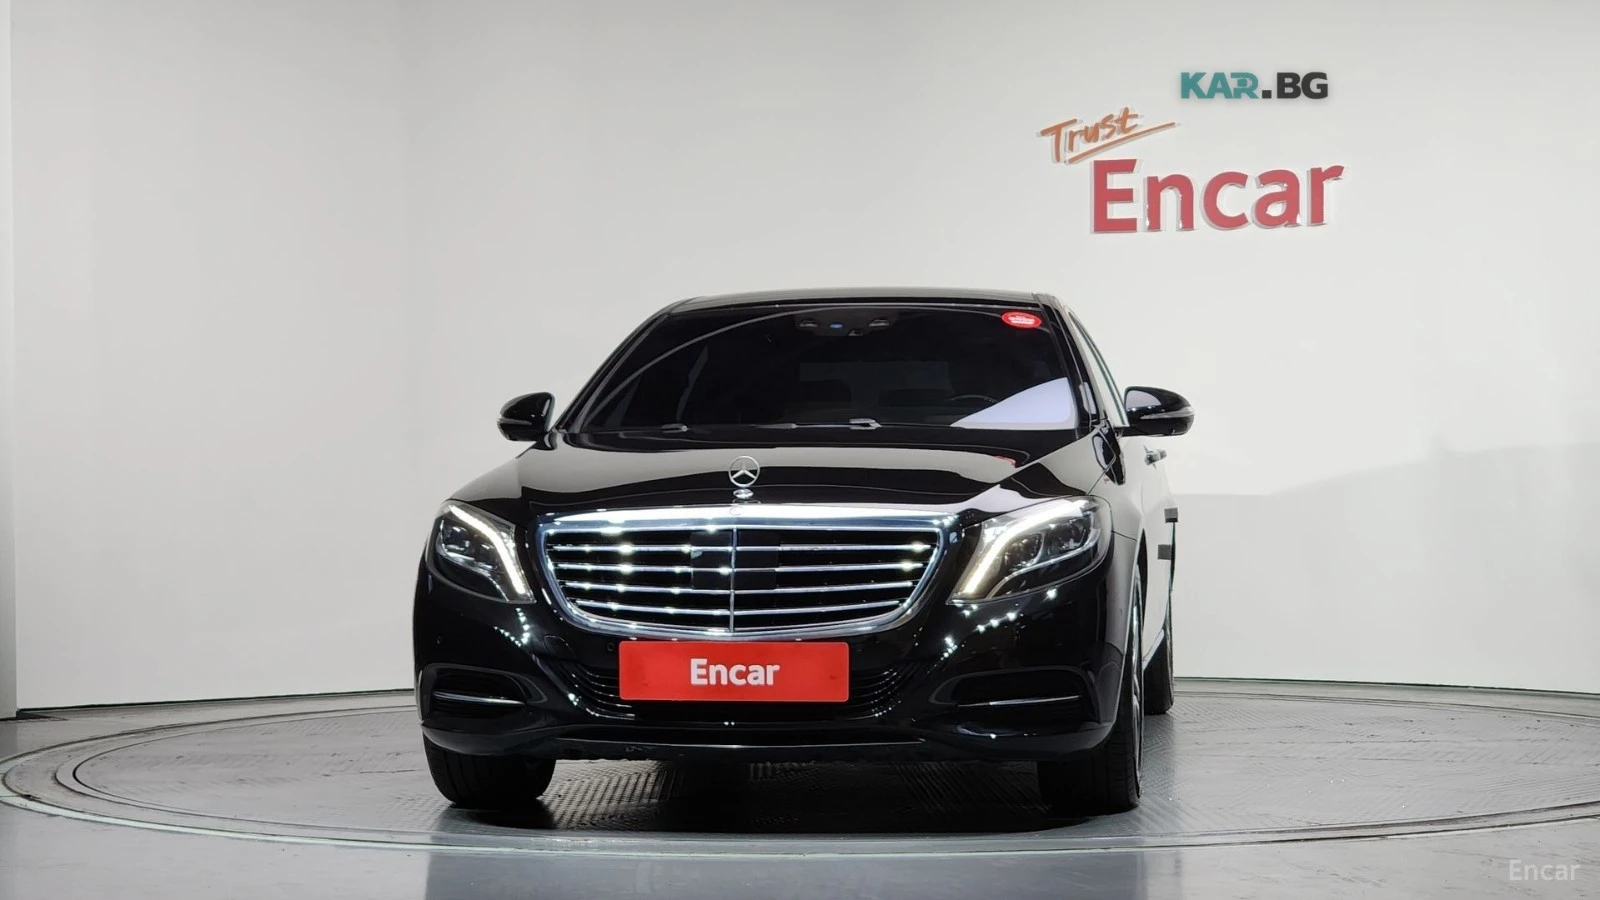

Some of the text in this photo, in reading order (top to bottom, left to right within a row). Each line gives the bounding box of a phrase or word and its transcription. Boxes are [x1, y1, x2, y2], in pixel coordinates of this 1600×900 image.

[1040, 107, 1139, 162] Trust
[1092, 158, 1345, 232] Encar
[690, 658, 780, 686] Encar
